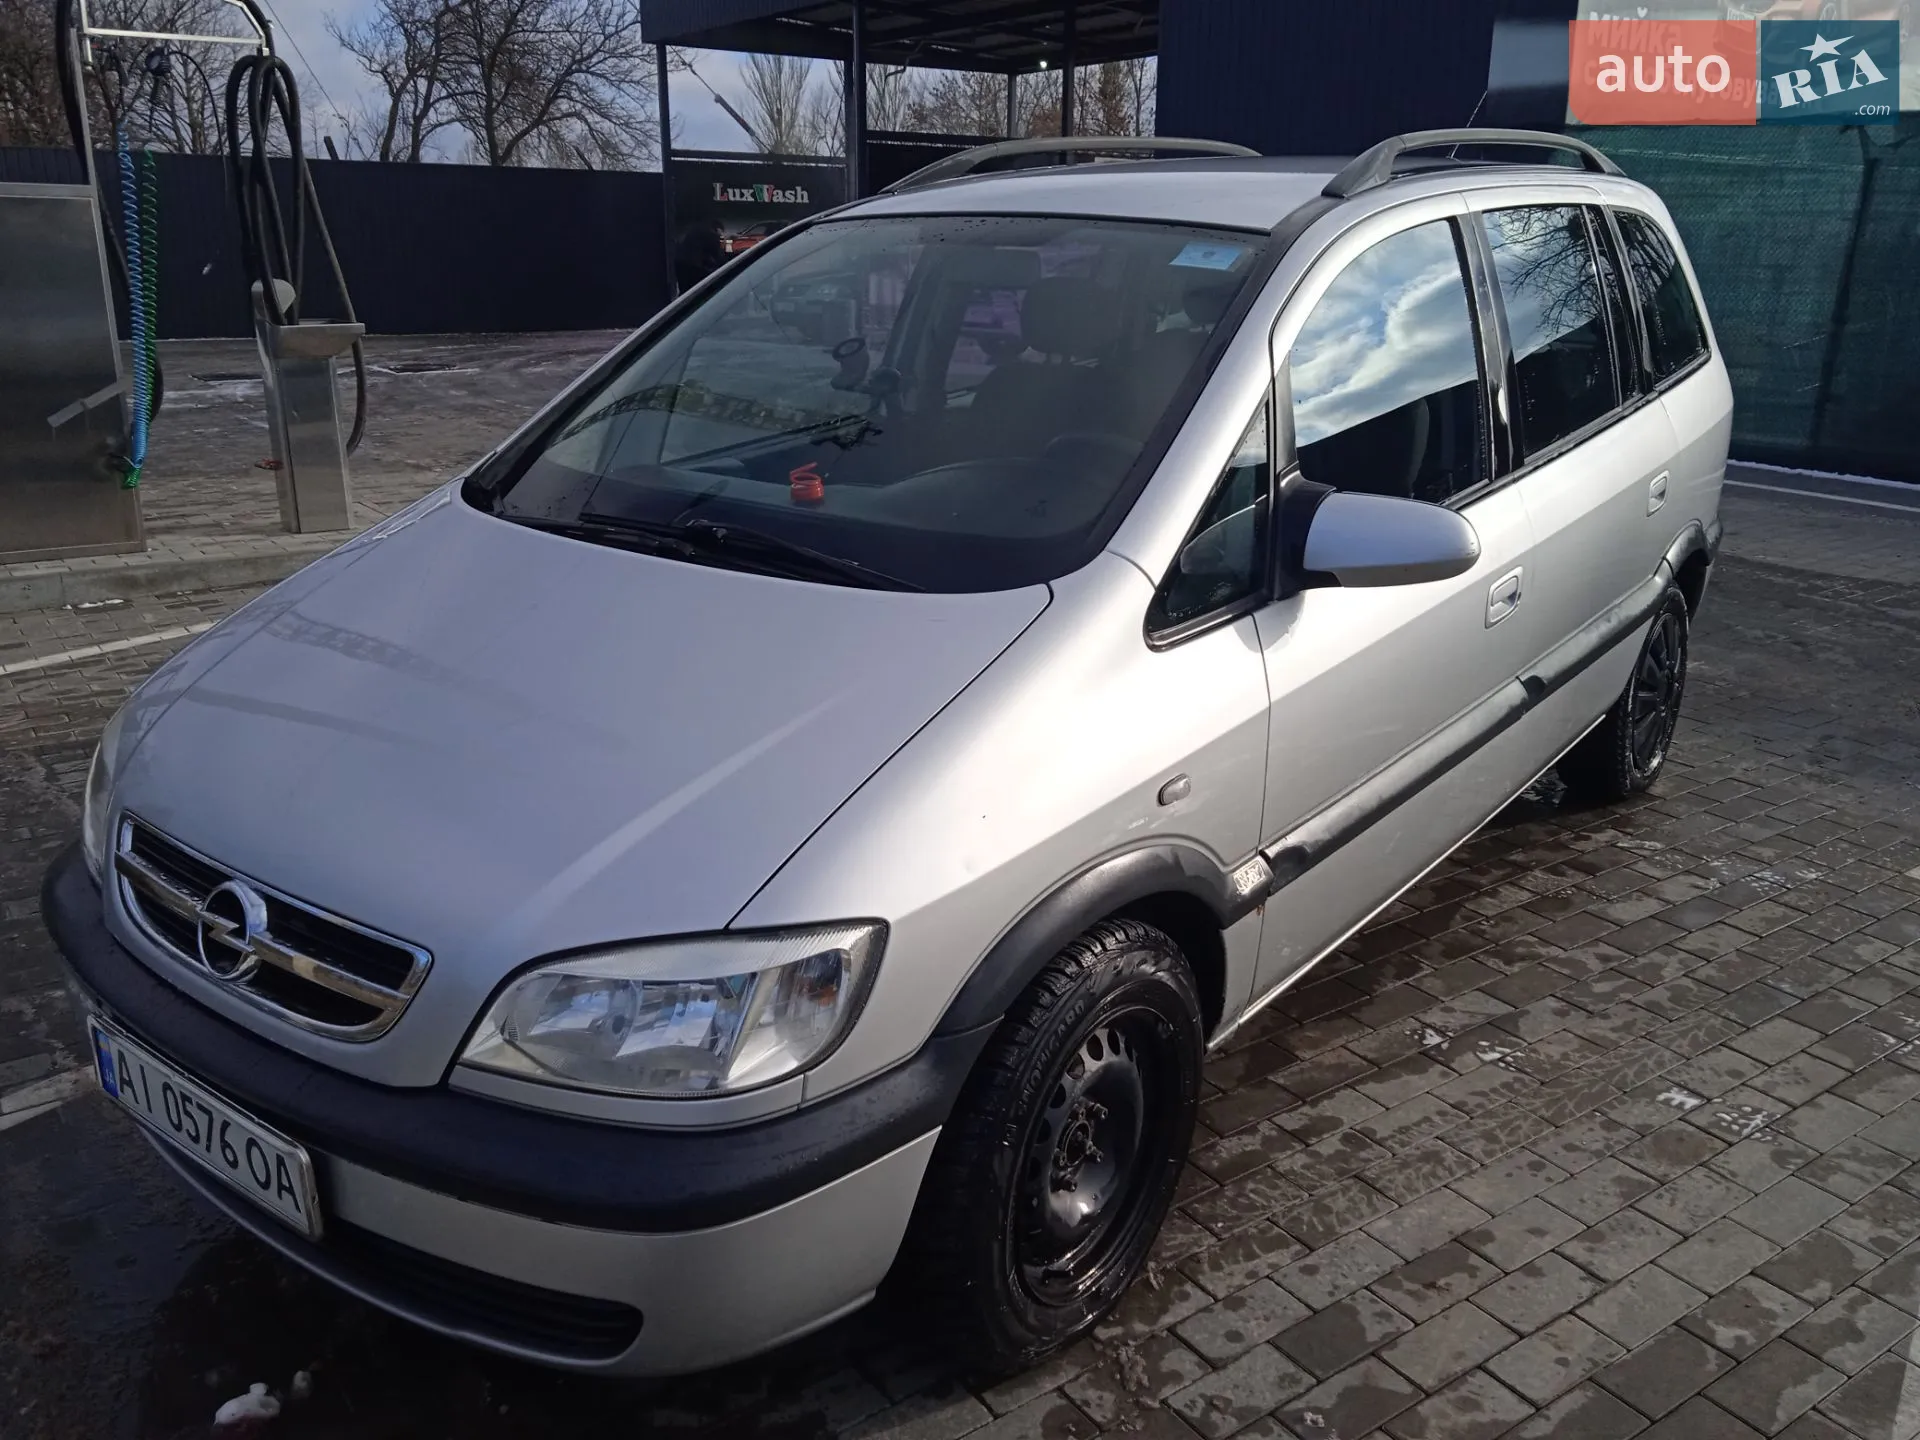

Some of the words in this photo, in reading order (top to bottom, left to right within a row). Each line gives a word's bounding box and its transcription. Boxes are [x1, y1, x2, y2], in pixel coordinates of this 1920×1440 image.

[713, 182, 809, 203] LuxWash
[118, 1049, 152, 1113] AI
[162, 1081, 239, 1170] 0576
[246, 1137, 301, 1213] OA
